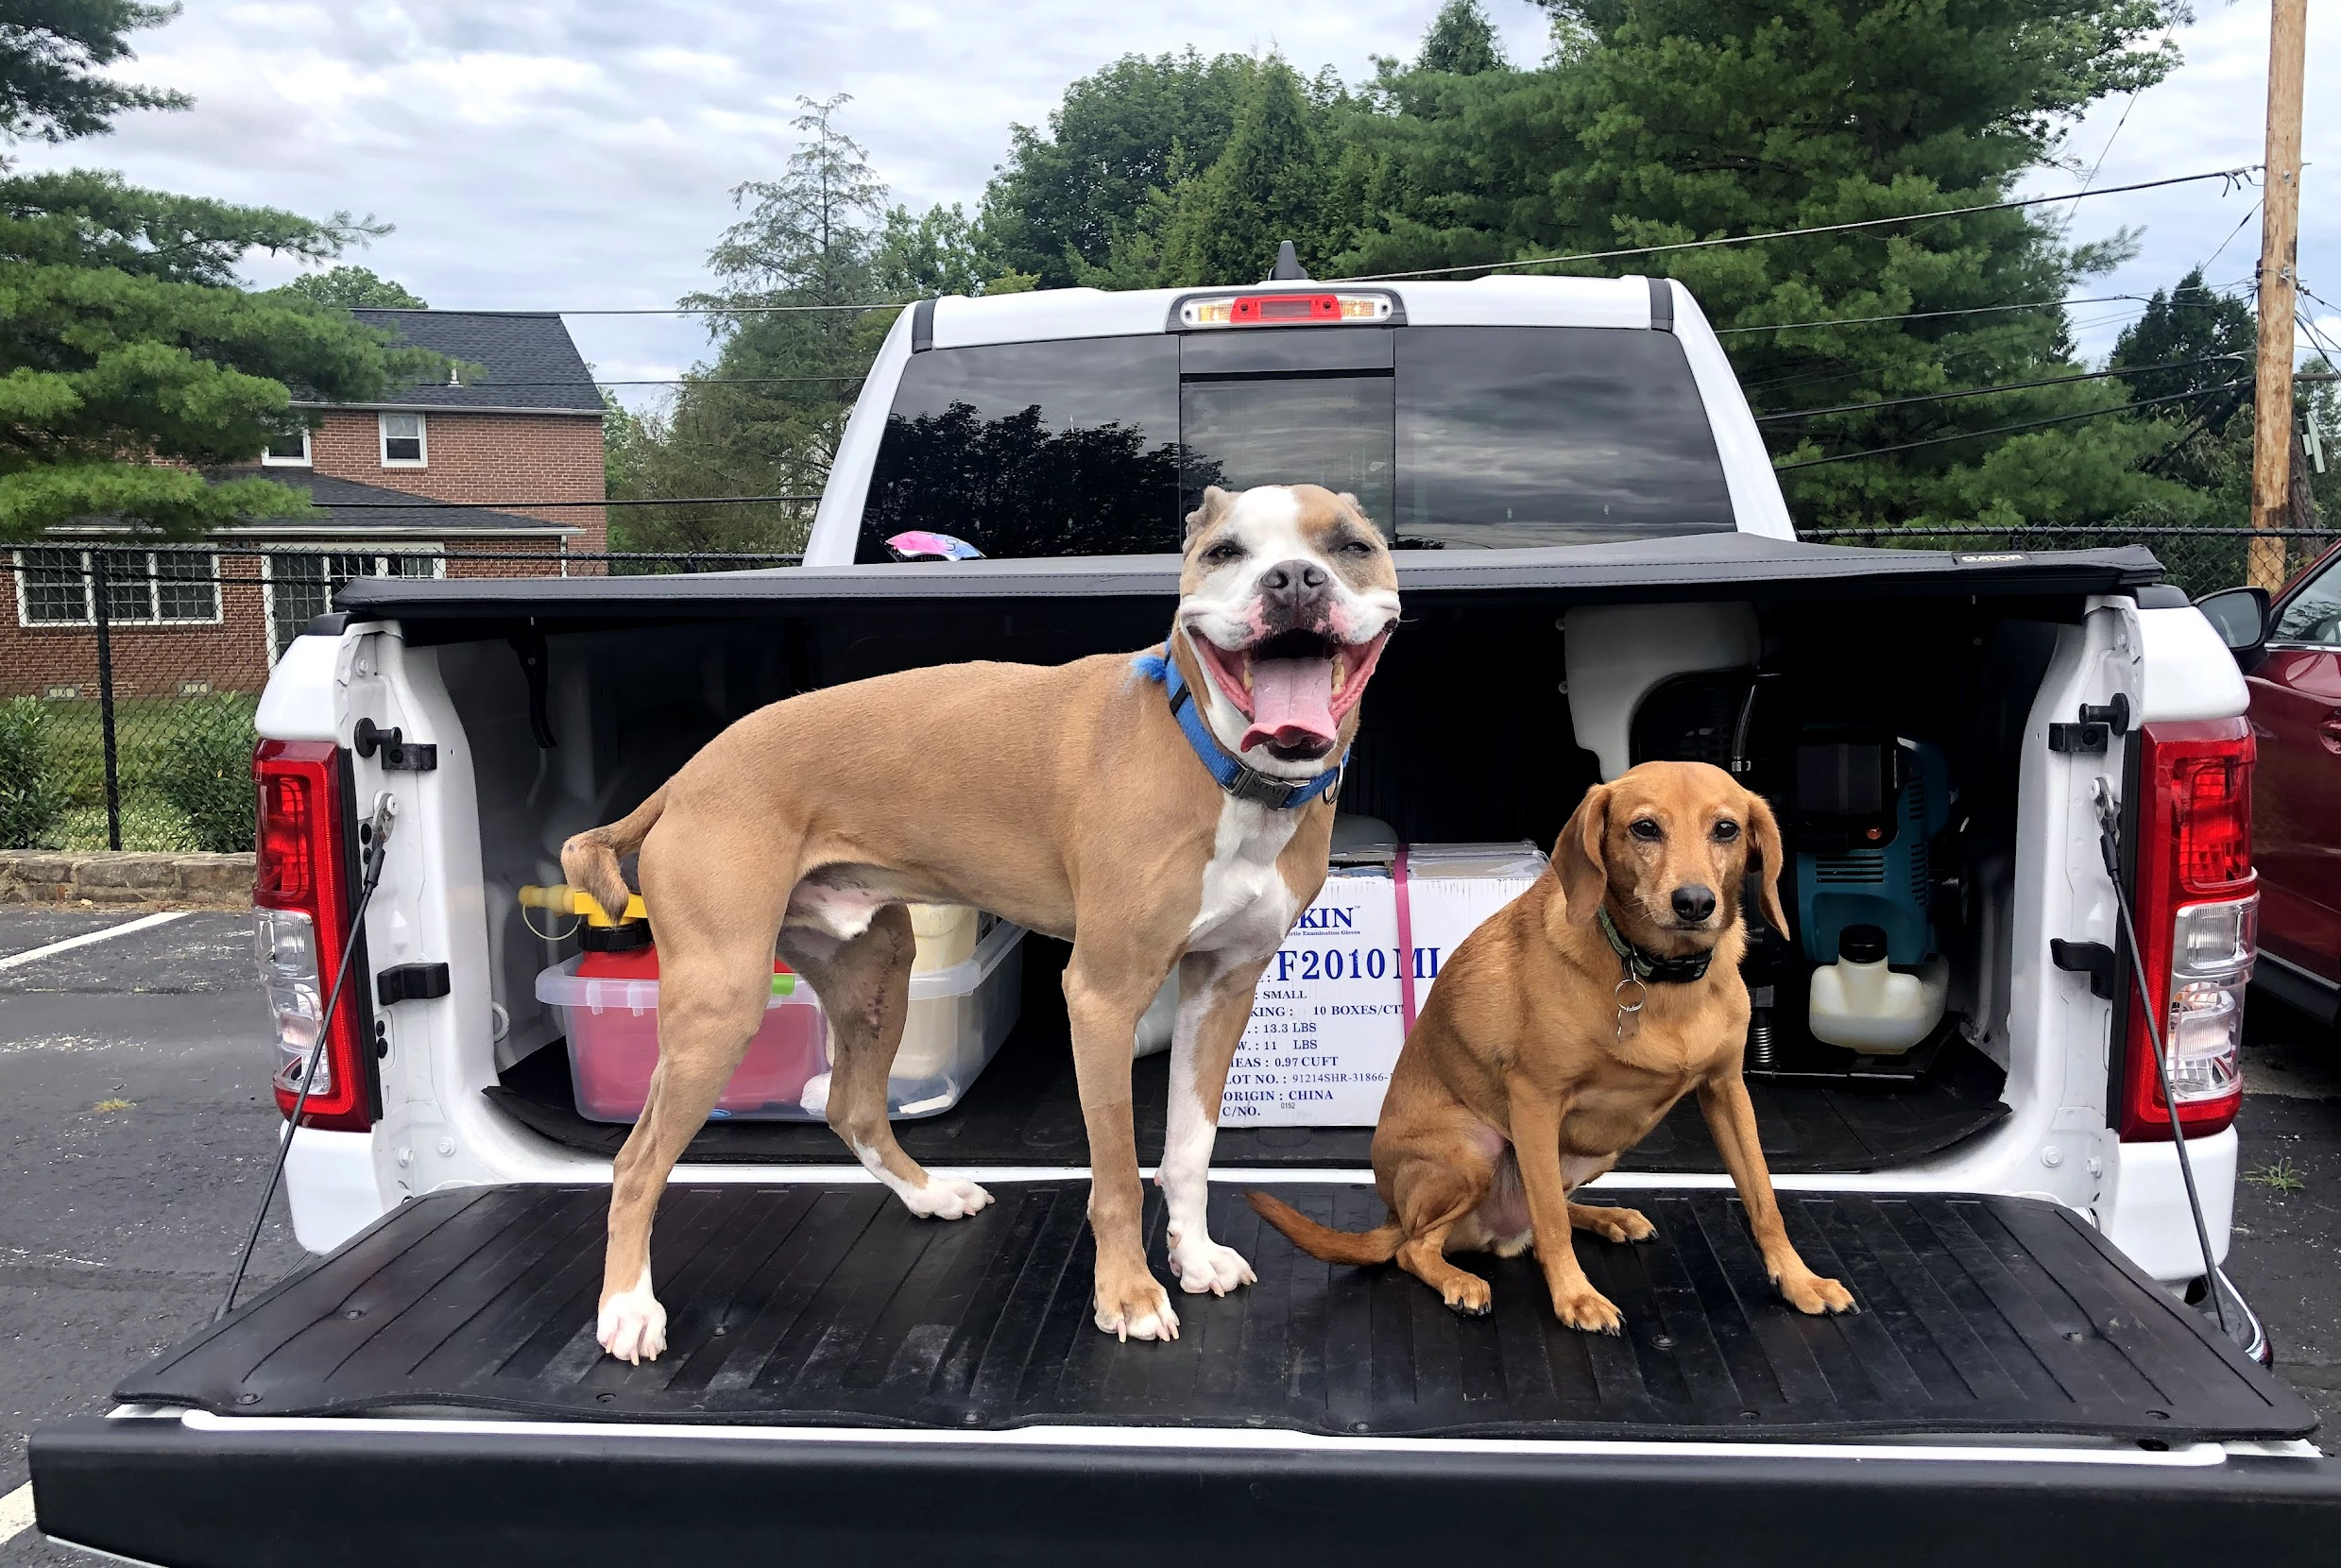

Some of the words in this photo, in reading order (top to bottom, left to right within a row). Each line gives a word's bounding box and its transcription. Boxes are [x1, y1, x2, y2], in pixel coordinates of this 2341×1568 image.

[1263, 990, 1307, 999] SMALL
[1250, 1006, 1286, 1017] KING
[1314, 1005, 1326, 1015] 10
[1264, 1023, 1289, 1033] 13.3
[1292, 1022, 1317, 1033] LBS
[1265, 1041, 1276, 1050] 11
[1293, 1039, 1318, 1050] LBS
[1274, 1057, 1298, 1067] 0.97
[1301, 1056, 1339, 1066] CUFT
[1292, 1072, 1393, 1083] 91214SHR-31866-
[1289, 1089, 1334, 1100] CHINA
[1222, 1105, 1261, 1116] C/NO.
